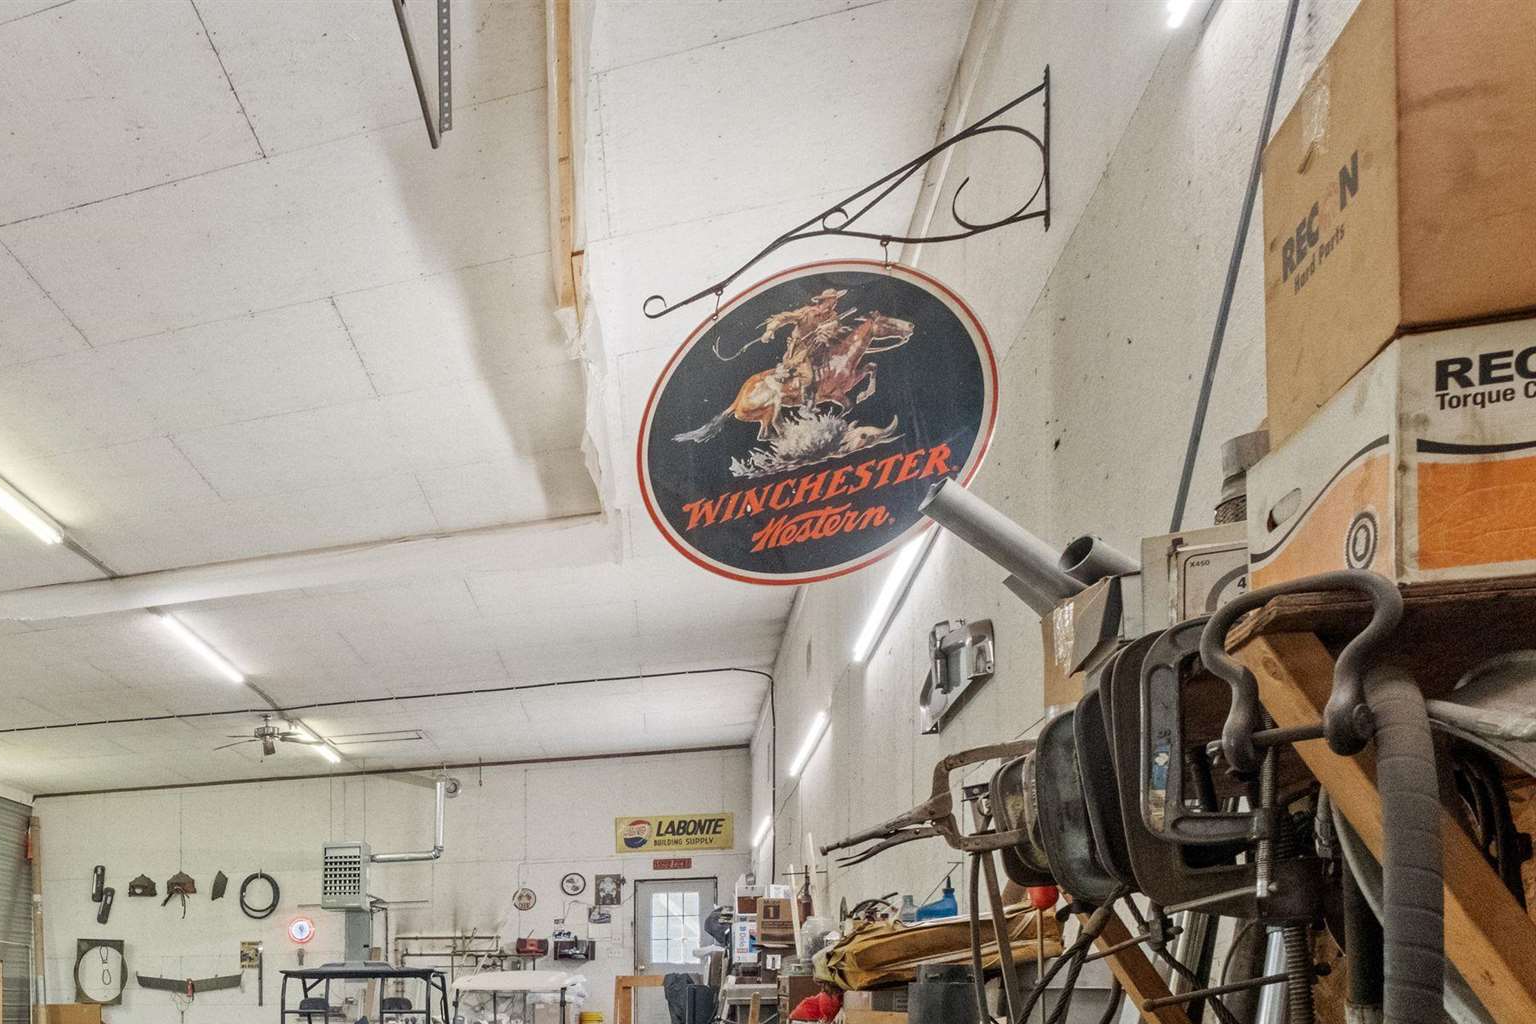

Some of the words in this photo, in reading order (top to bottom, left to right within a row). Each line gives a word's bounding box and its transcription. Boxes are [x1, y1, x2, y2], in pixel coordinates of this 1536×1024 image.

[1294, 253, 1316, 295] Hard
[1319, 223, 1345, 265] Parts
[1435, 387, 1516, 411] Torque
[682, 443, 953, 532] WINCHESTER
[751, 502, 891, 553] Western
[1189, 559, 1210, 568] X450
[656, 818, 725, 837] LABONTE
[653, 839, 683, 847] BUILDING
[686, 837, 714, 846] SUPPLY
